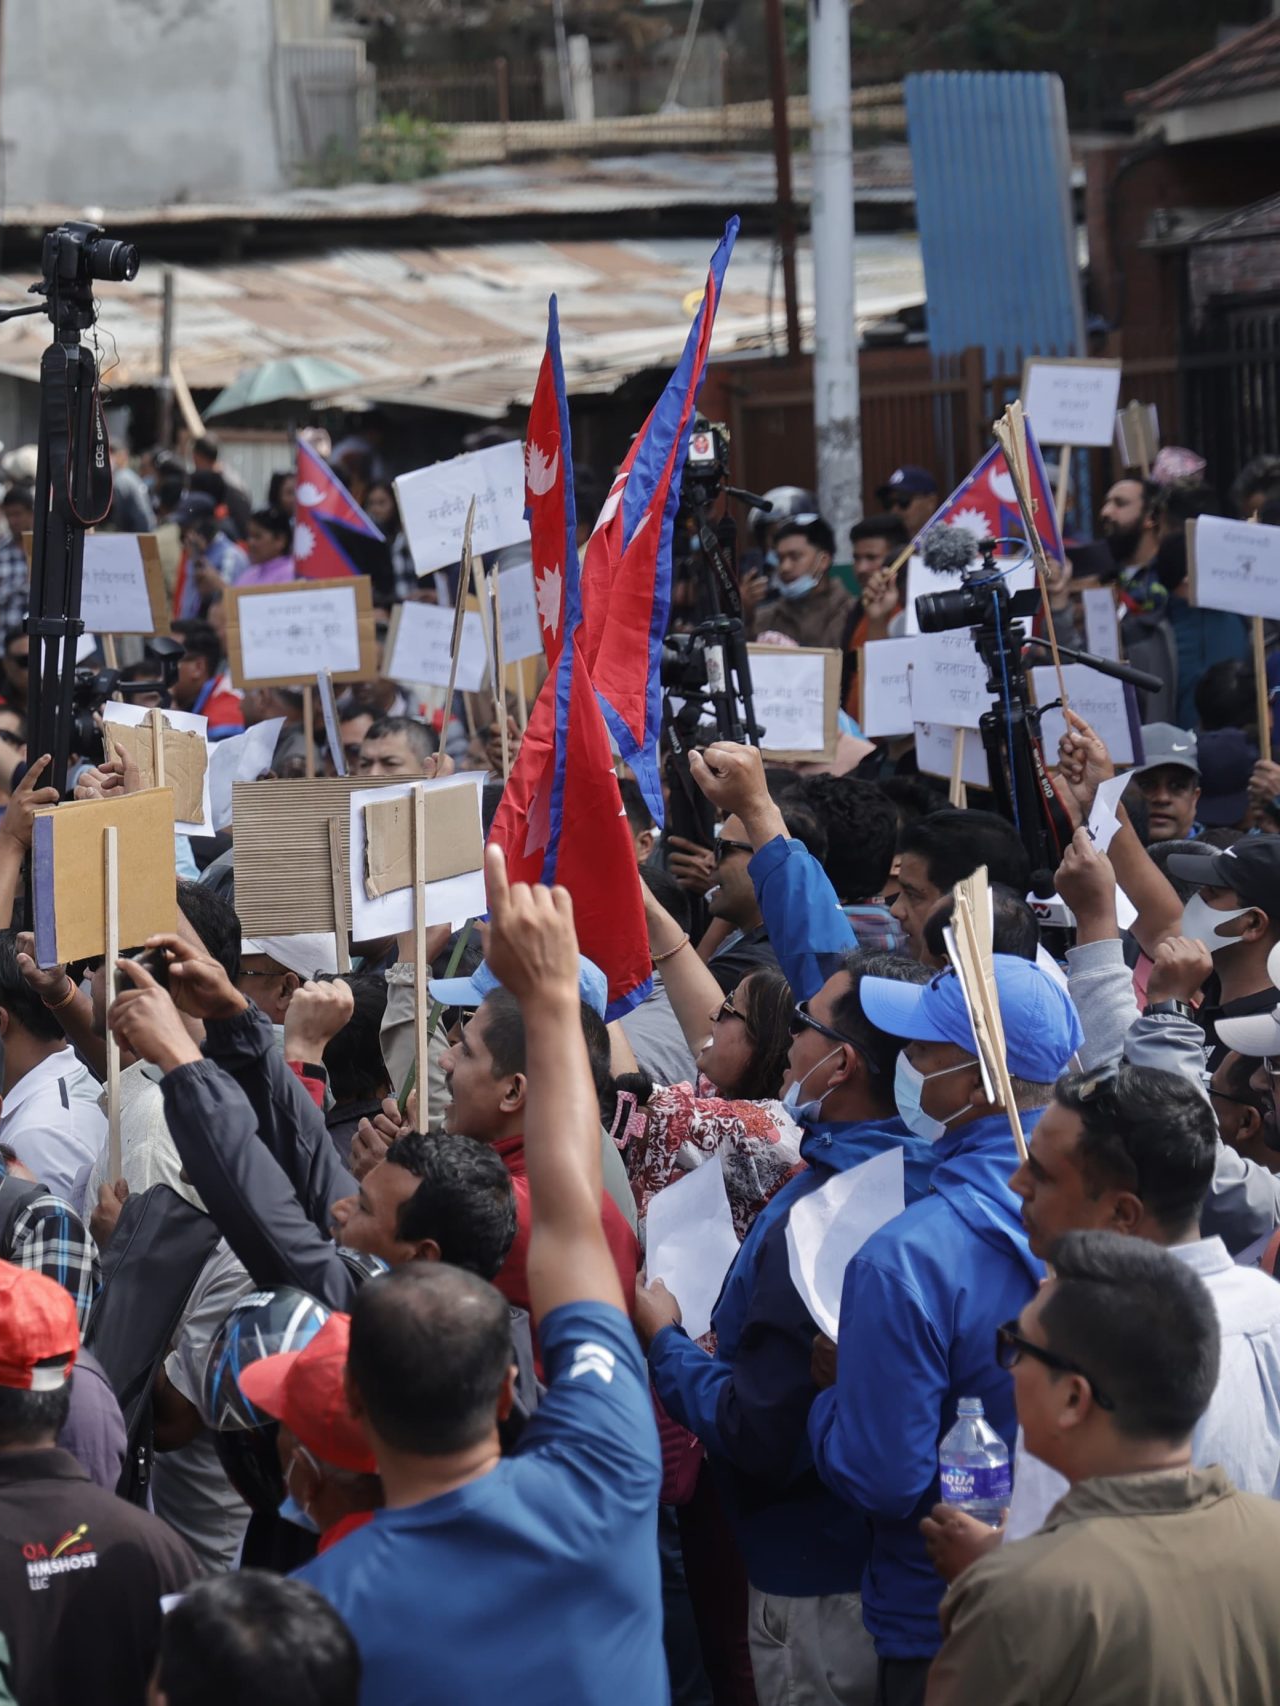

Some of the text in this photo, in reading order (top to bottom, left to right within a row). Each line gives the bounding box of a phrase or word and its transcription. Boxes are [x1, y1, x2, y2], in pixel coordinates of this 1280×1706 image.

[95, 443, 105, 468] EOS
[940, 1472, 975, 1487] AQUA
[950, 1485, 974, 1494] ANNA
[26, 1552, 98, 1577] HMSHOST
[29, 1577, 51, 1591] LLC
